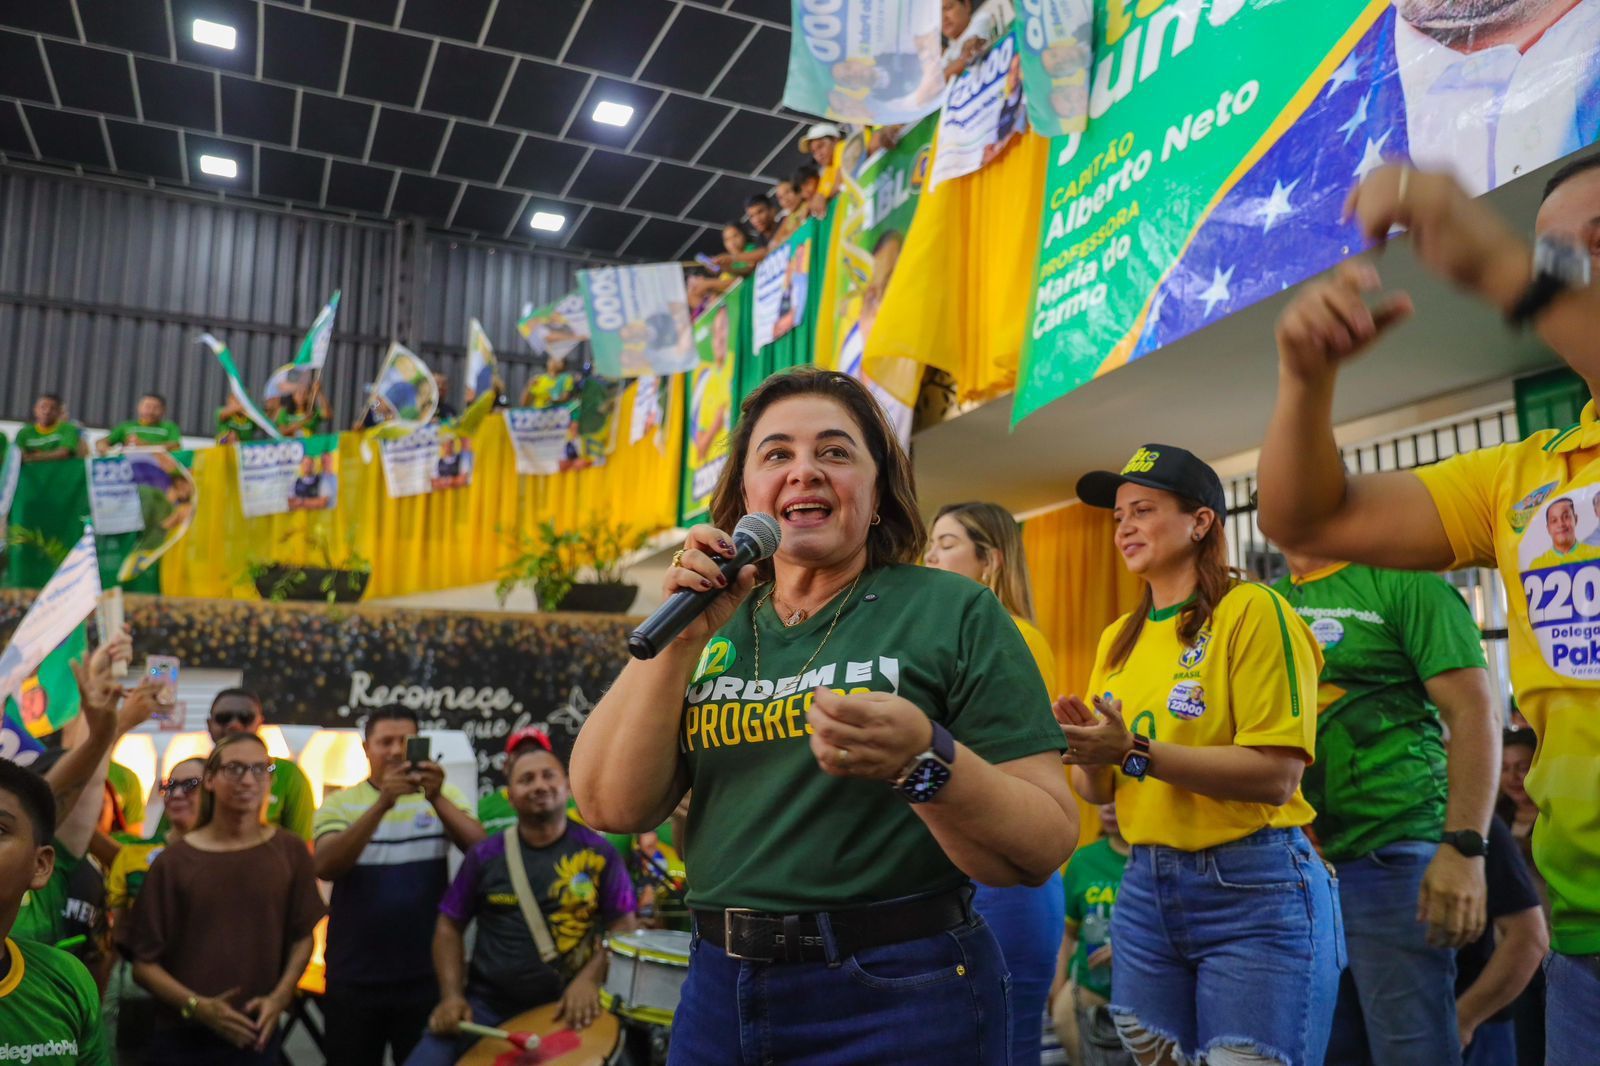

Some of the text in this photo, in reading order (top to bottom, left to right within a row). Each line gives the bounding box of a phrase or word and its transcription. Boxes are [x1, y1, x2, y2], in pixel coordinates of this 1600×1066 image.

[1044, 79, 1259, 249] Alberto Neto
[1051, 131, 1134, 210] CAPITÃO
[1035, 234, 1131, 313] Maria do
[1039, 200, 1139, 282] PROFESSORA
[1033, 282, 1107, 340] Carmo
[1523, 565, 1600, 624] 220
[685, 660, 873, 704] ORDEM E
[1170, 700, 1204, 716] 22000
